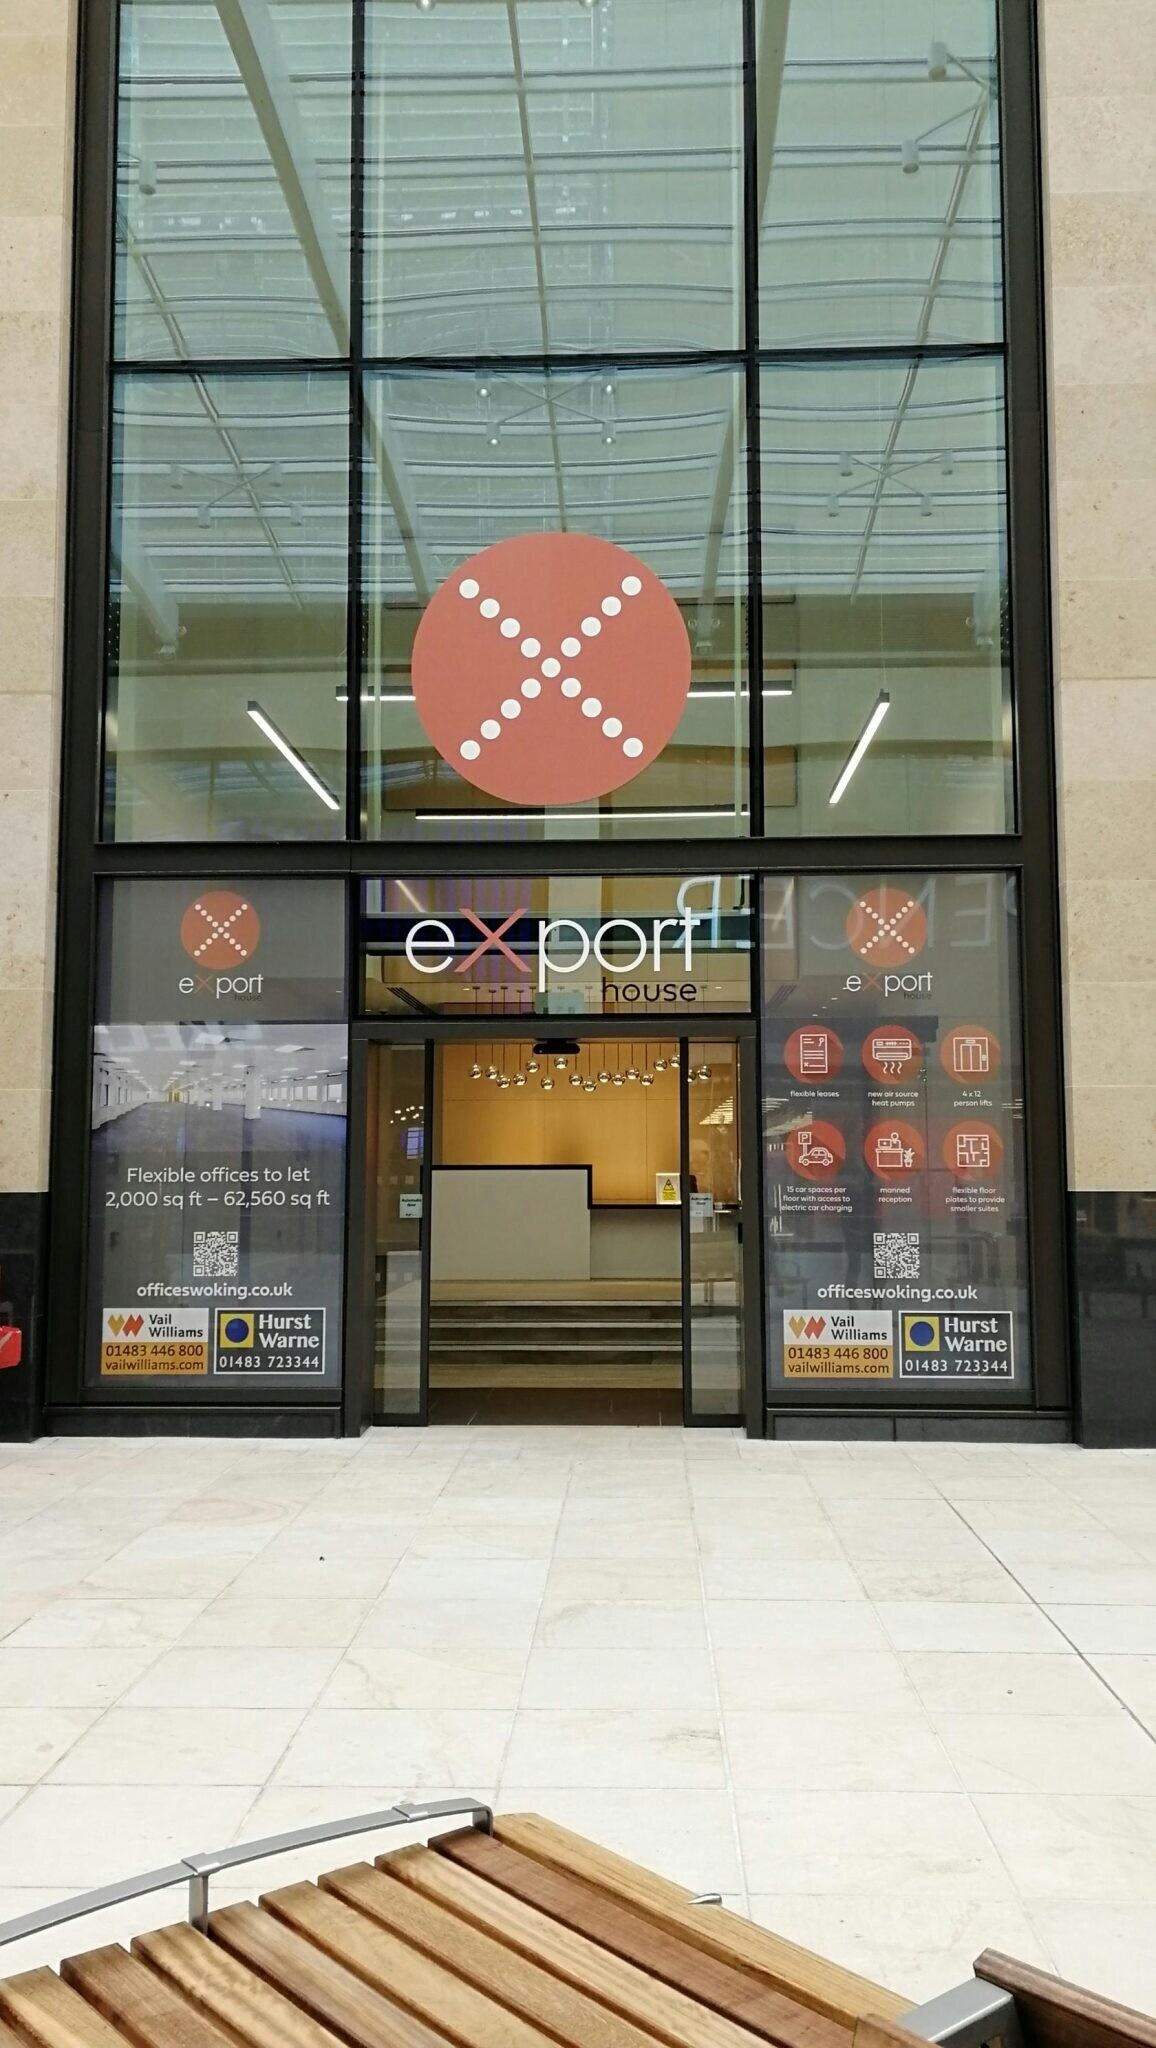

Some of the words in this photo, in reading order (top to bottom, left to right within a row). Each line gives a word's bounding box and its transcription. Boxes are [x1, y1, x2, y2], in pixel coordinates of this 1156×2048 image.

[602, 977, 697, 1002] house
[904, 991, 932, 1000] house
[884, 1090, 894, 1098] air
[127, 1167, 195, 1183] Flexible
[200, 1167, 259, 1182] offices
[264, 1168, 282, 1182] to
[287, 1166, 310, 1182] let
[105, 1191, 158, 1209] 2,000
[163, 1194, 184, 1209] sq
[188, 1191, 202, 1206] ft
[224, 1190, 285, 1208] 62,560
[290, 1193, 311, 1208] sq
[316, 1190, 330, 1206] ft
[878, 1196, 912, 1204] reception
[945, 1196, 967, 1204] plates
[978, 1196, 1005, 1204] provide
[820, 1204, 853, 1213] charging
[137, 1283, 293, 1299] officeswoking.co.uk
[817, 1284, 978, 1302] officeswoking.co.uk
[149, 1313, 172, 1325] Vail
[259, 1313, 311, 1330] Hurst
[831, 1316, 854, 1327] Vail
[944, 1317, 998, 1334] Hurst
[149, 1326, 203, 1338] Williams
[831, 1328, 887, 1340] Williams
[259, 1332, 320, 1349] Warne
[944, 1336, 1008, 1352] Warne
[105, 1345, 147, 1357] 01483
[151, 1344, 176, 1357] 446
[178, 1344, 203, 1357] 800
[788, 1347, 830, 1360] 01483
[834, 1347, 859, 1360] 446
[863, 1347, 888, 1360] 800
[105, 1359, 204, 1371] vailwilliams.com
[219, 1356, 261, 1368] 01483
[267, 1356, 319, 1368] 723344
[788, 1361, 889, 1374] vailwilliams.com
[905, 1360, 948, 1372] 01483
[955, 1360, 1008, 1372] 723344
